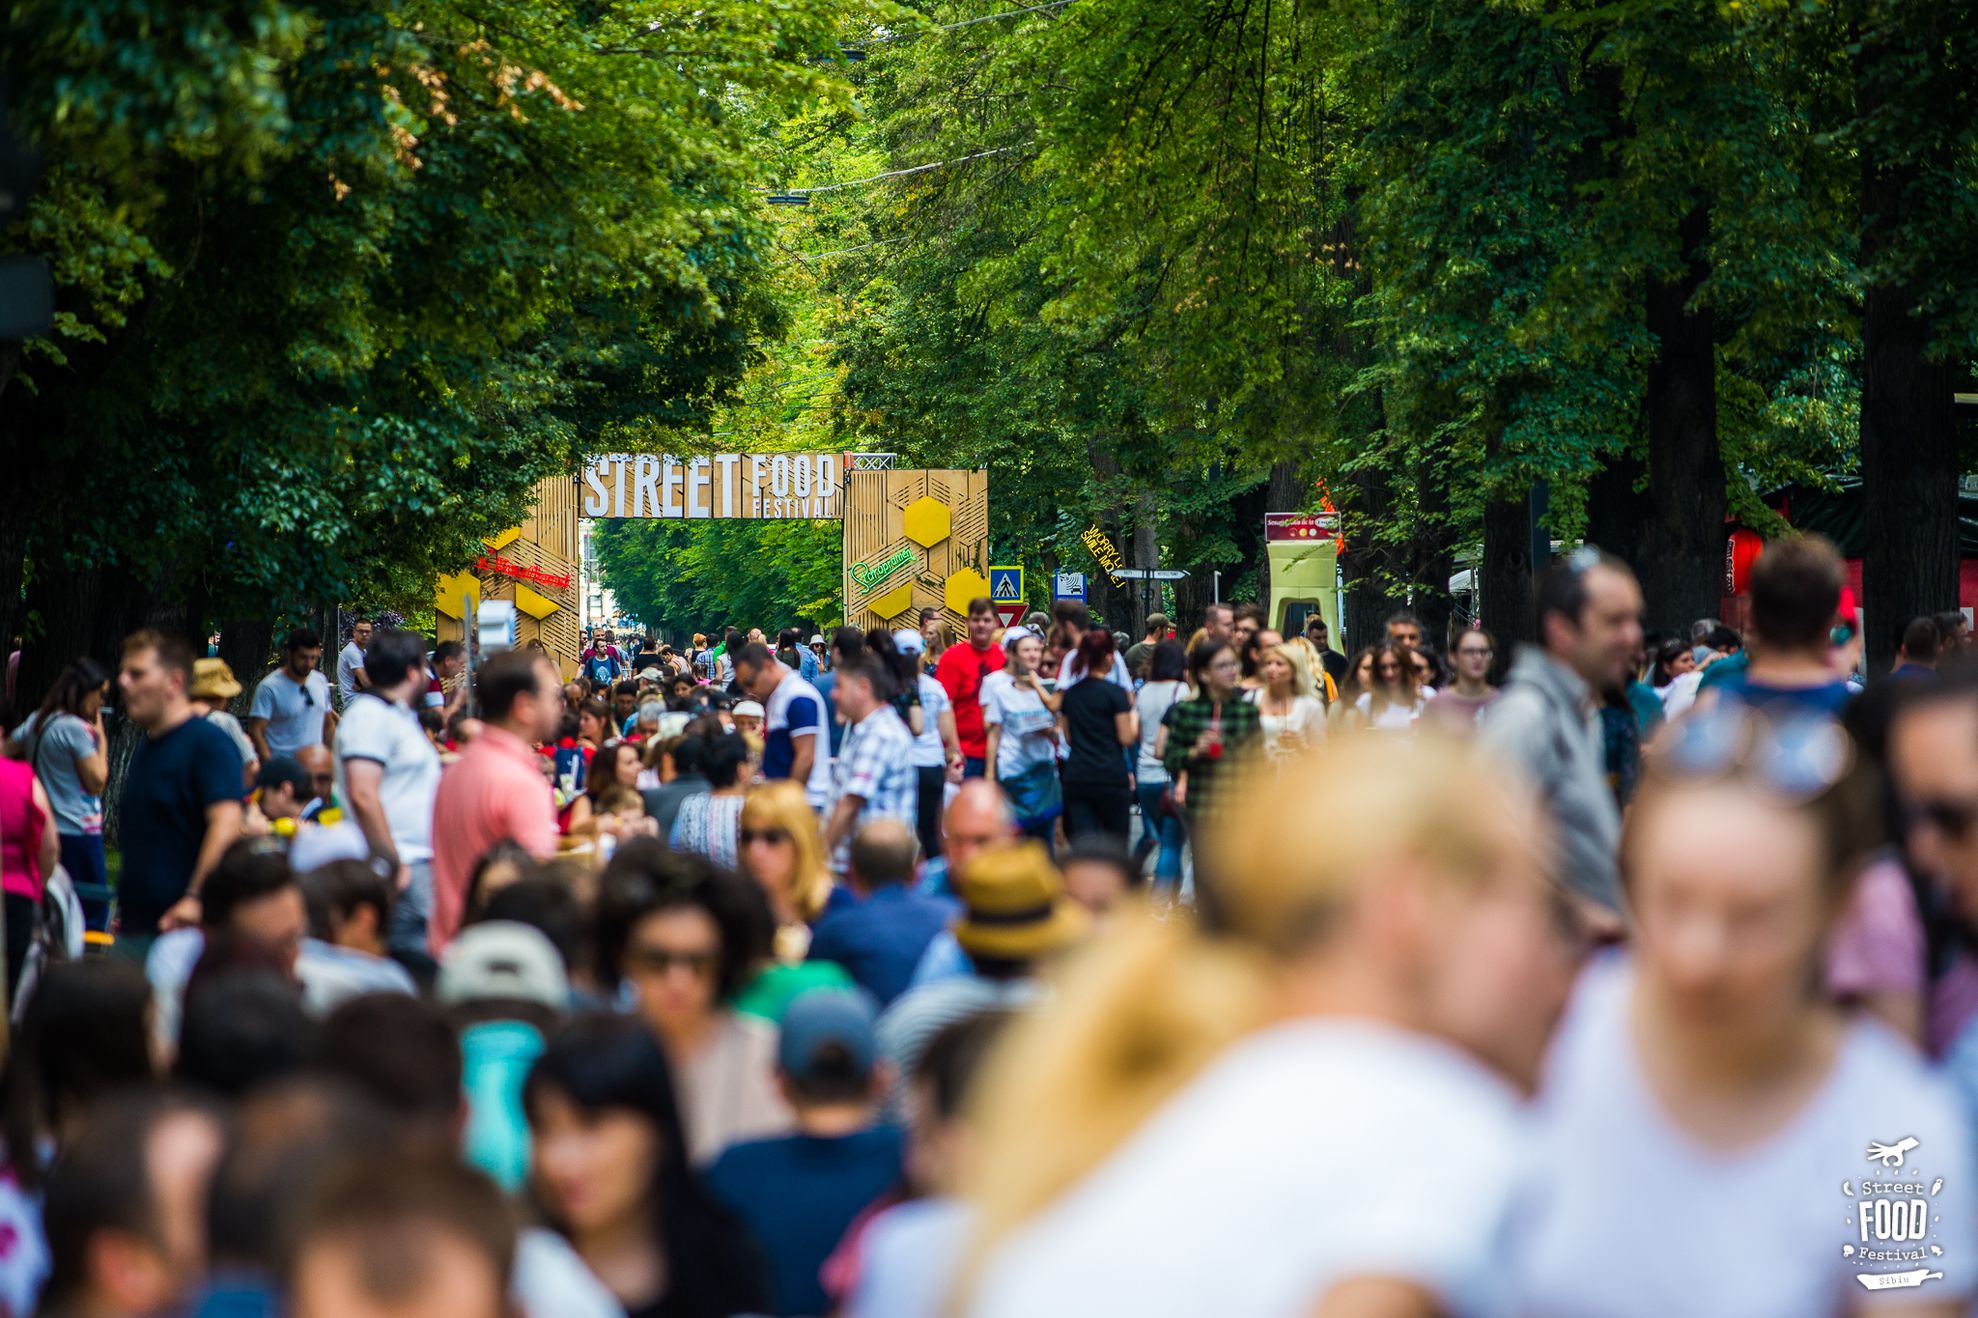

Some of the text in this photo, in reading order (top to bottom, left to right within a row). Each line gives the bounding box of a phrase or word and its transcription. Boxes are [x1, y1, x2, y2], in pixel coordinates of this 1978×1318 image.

[585, 453, 835, 517] STREET FOOD
[753, 498, 832, 518] FESTIVAL
[1081, 530, 1104, 557] SMILE
[1089, 523, 1119, 557] WORRY
[850, 549, 916, 594] Staropramen
